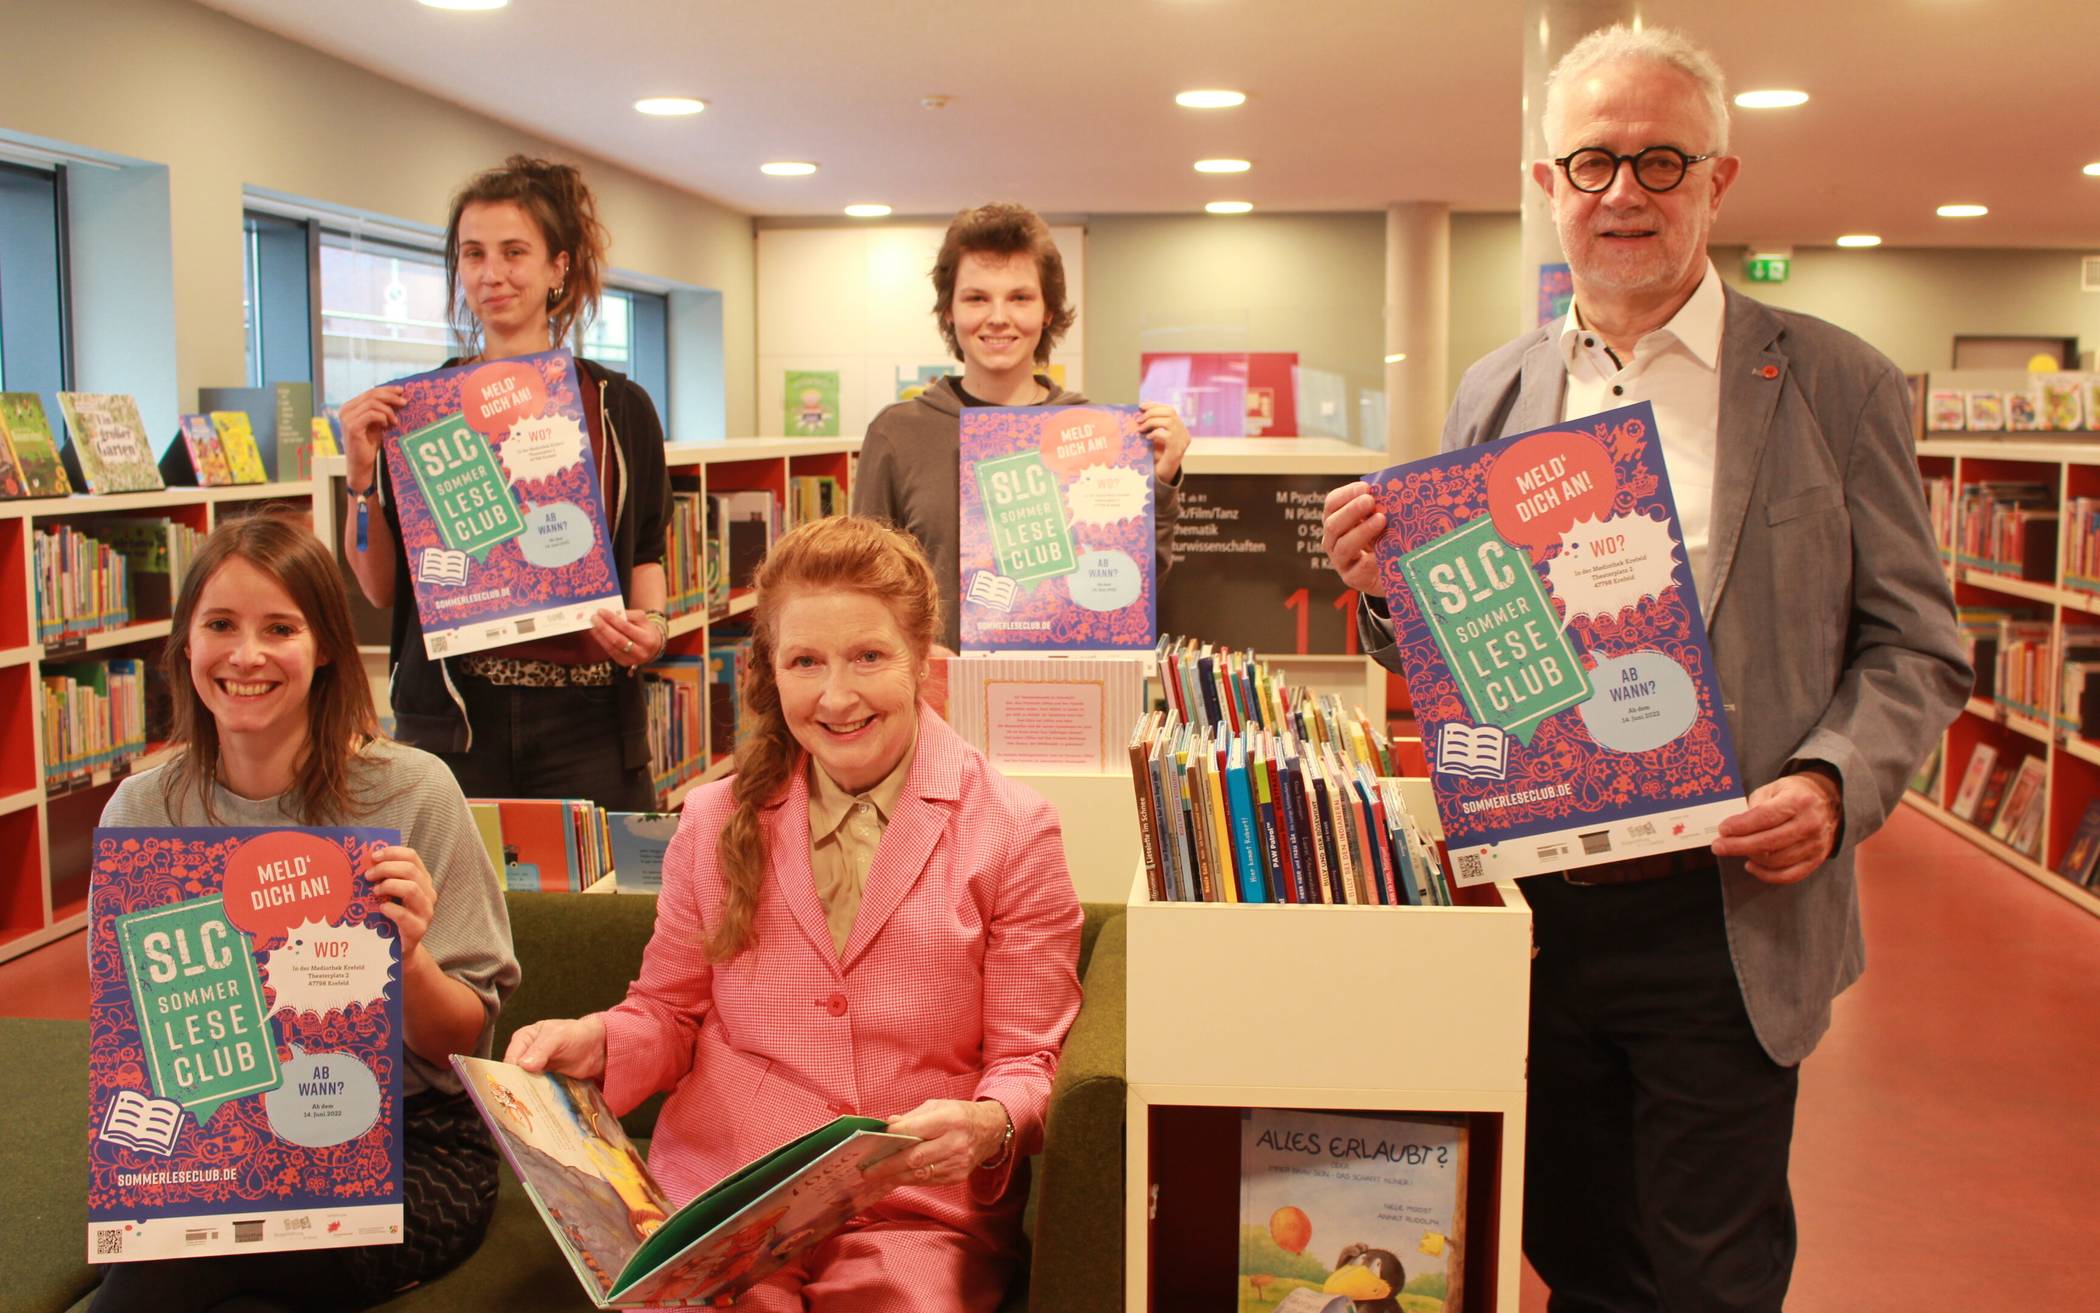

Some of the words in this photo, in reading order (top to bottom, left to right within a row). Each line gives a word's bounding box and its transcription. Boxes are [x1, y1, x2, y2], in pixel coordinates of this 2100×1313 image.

[480, 396, 511, 419] DICH
[512, 386, 533, 406] AN!
[528, 428, 552, 441] WO?
[1056, 441, 1086, 459] DICH
[1088, 436, 1108, 452] AN!
[418, 428, 479, 477] SLC
[435, 465, 488, 496] SOMMER
[991, 464, 1048, 505] SLC
[443, 480, 498, 519] LESE
[1515, 486, 1561, 522] DICH
[1561, 470, 1594, 501] AN!
[454, 505, 509, 542] CLUB
[537, 521, 568, 535] WANN?
[545, 512, 557, 522] AB
[1000, 504, 1052, 525] SOMMER
[1004, 519, 1057, 548] LESE
[1589, 534, 1625, 558] WO?
[1011, 542, 1062, 570] CLUB
[1098, 558, 1109, 568] AB
[1088, 569, 1118, 578] WANN?
[1429, 539, 1515, 614] SLC
[434, 588, 511, 611] SOMMERLESECLUB.DE
[976, 621, 1051, 631] SOMMERLESECLUB.DE
[1455, 596, 1531, 643] SOMMER
[1467, 620, 1548, 678] LESE
[1485, 655, 1565, 714] CLUB
[1622, 667, 1638, 683] AB
[1609, 680, 1656, 702] WANN?
[1137, 796, 1147, 822] Schnee
[1462, 783, 1572, 815] SOMMERLESECLUB.DE
[1270, 849, 1279, 868] PAW
[250, 881, 298, 911] DICH
[300, 875, 332, 900] AN!
[142, 919, 233, 985] SLC
[313, 941, 349, 958] WO?
[157, 978, 240, 1014] SOMMER
[163, 1003, 248, 1052] LESE
[173, 1041, 256, 1087] CLUB
[313, 1066, 330, 1080] AB
[298, 1081, 345, 1097] WANN?
[1256, 1129, 1321, 1155] ALLES
[117, 1167, 238, 1187] SOMMERLESECLUB.DE
